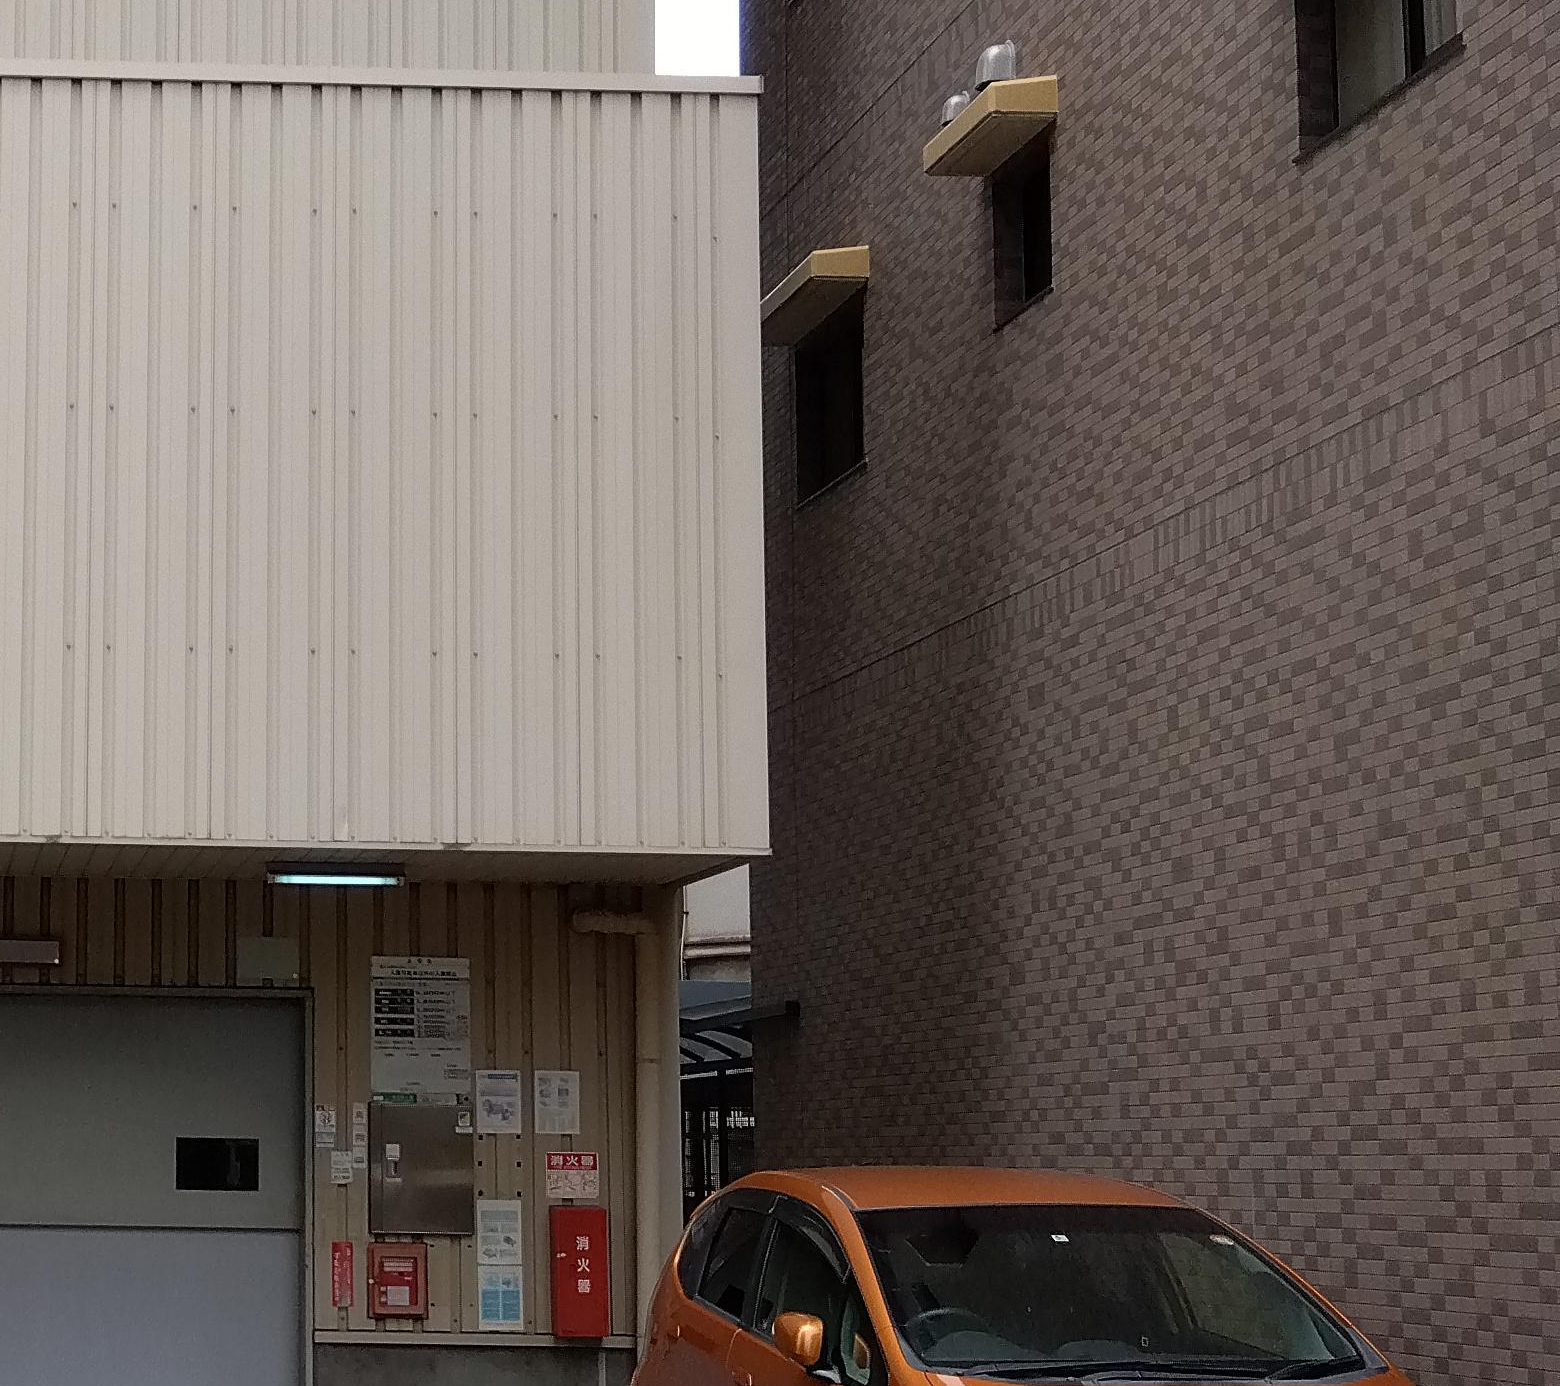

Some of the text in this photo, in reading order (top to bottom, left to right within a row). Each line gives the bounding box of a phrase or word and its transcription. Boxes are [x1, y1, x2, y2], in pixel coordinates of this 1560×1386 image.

[550, 1155, 594, 1166] 消火器
[575, 1236, 591, 1293] 消火器
